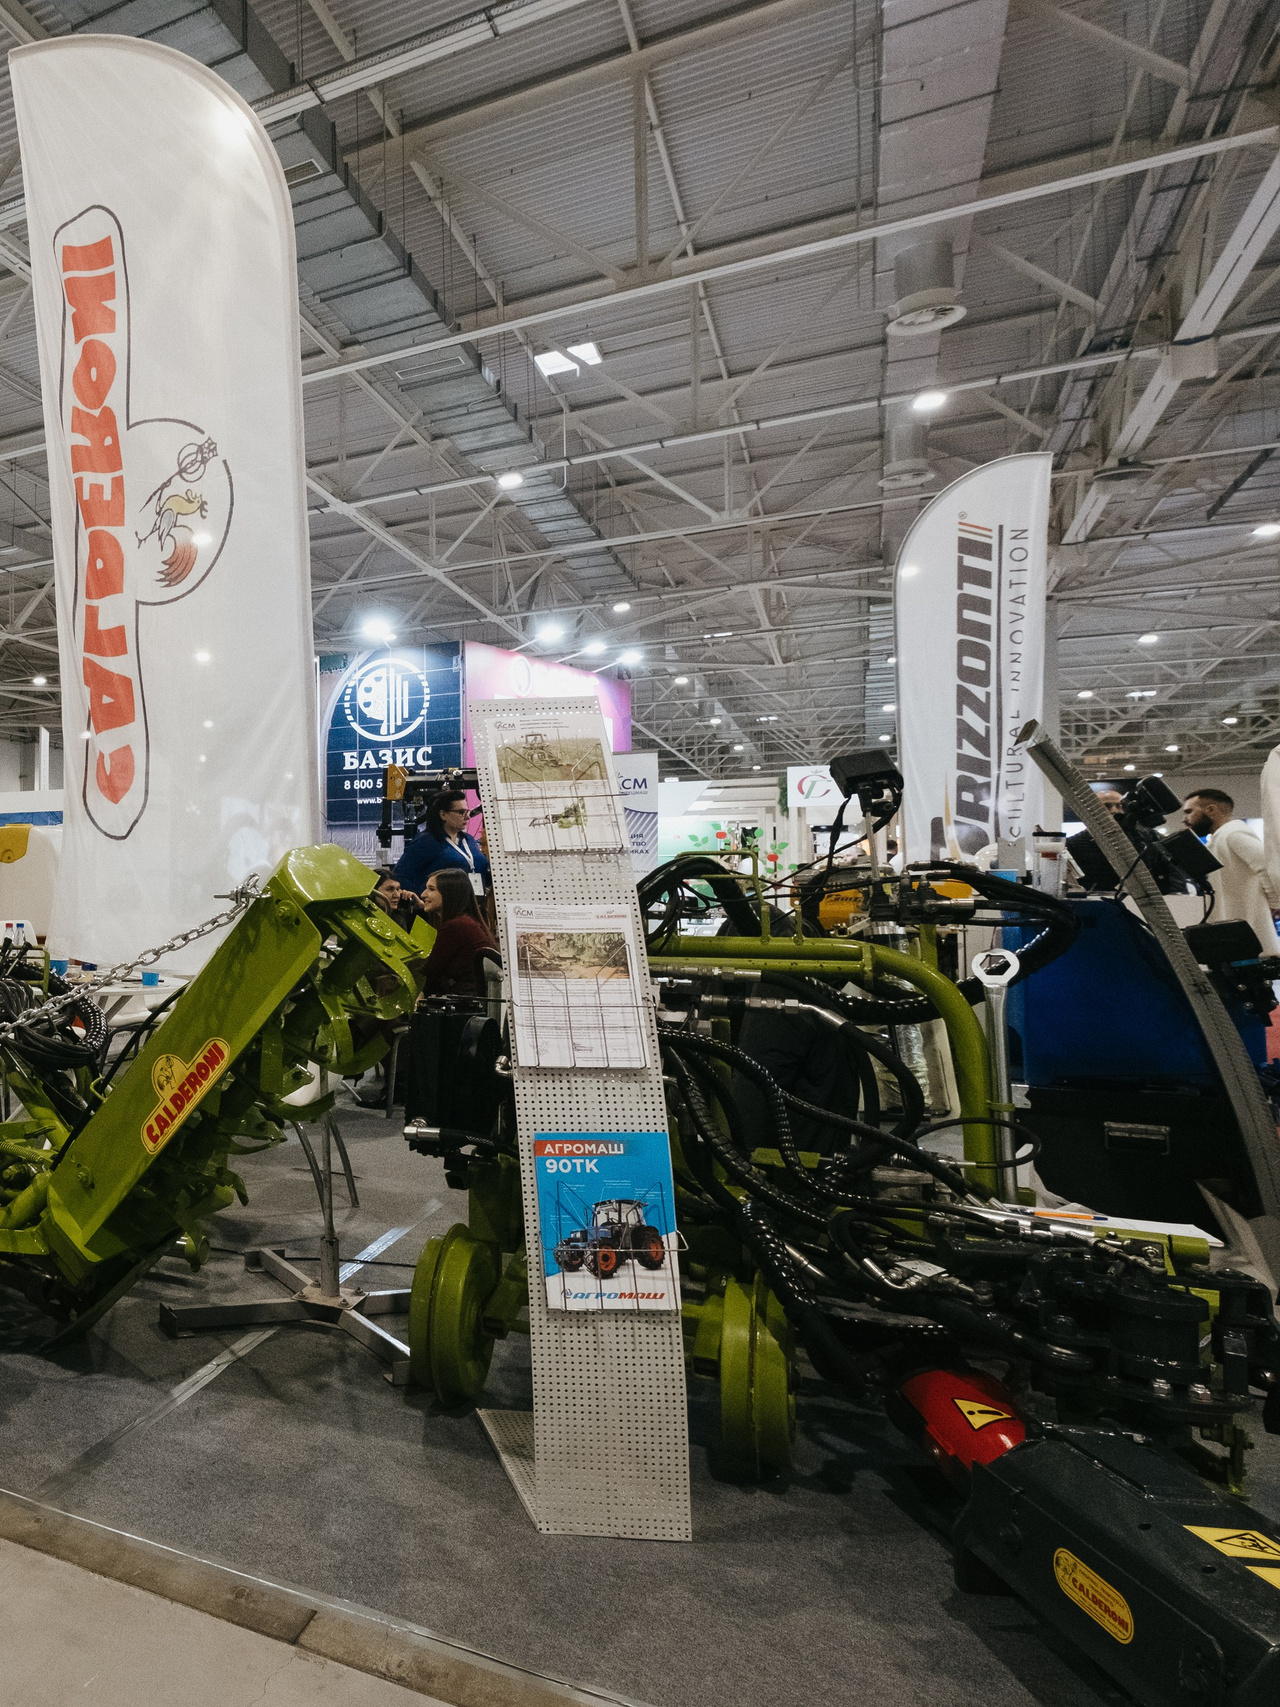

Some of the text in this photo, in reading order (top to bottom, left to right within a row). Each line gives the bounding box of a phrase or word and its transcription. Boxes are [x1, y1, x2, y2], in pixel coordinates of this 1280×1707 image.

[1009, 527, 1029, 692] INNOVATION
[343, 746, 433, 770] БАЗИС
[344, 780, 351, 790] 8
[353, 779, 373, 790] 800
[620, 778, 648, 790] СМ
[146, 1042, 226, 1145] CALDERONI
[544, 1143, 624, 1155] АГРОМАШ
[545, 1158, 599, 1173] 90ТК
[572, 1292, 666, 1300] АГРОМАШ
[1071, 1577, 1129, 1633] CALDERONI
